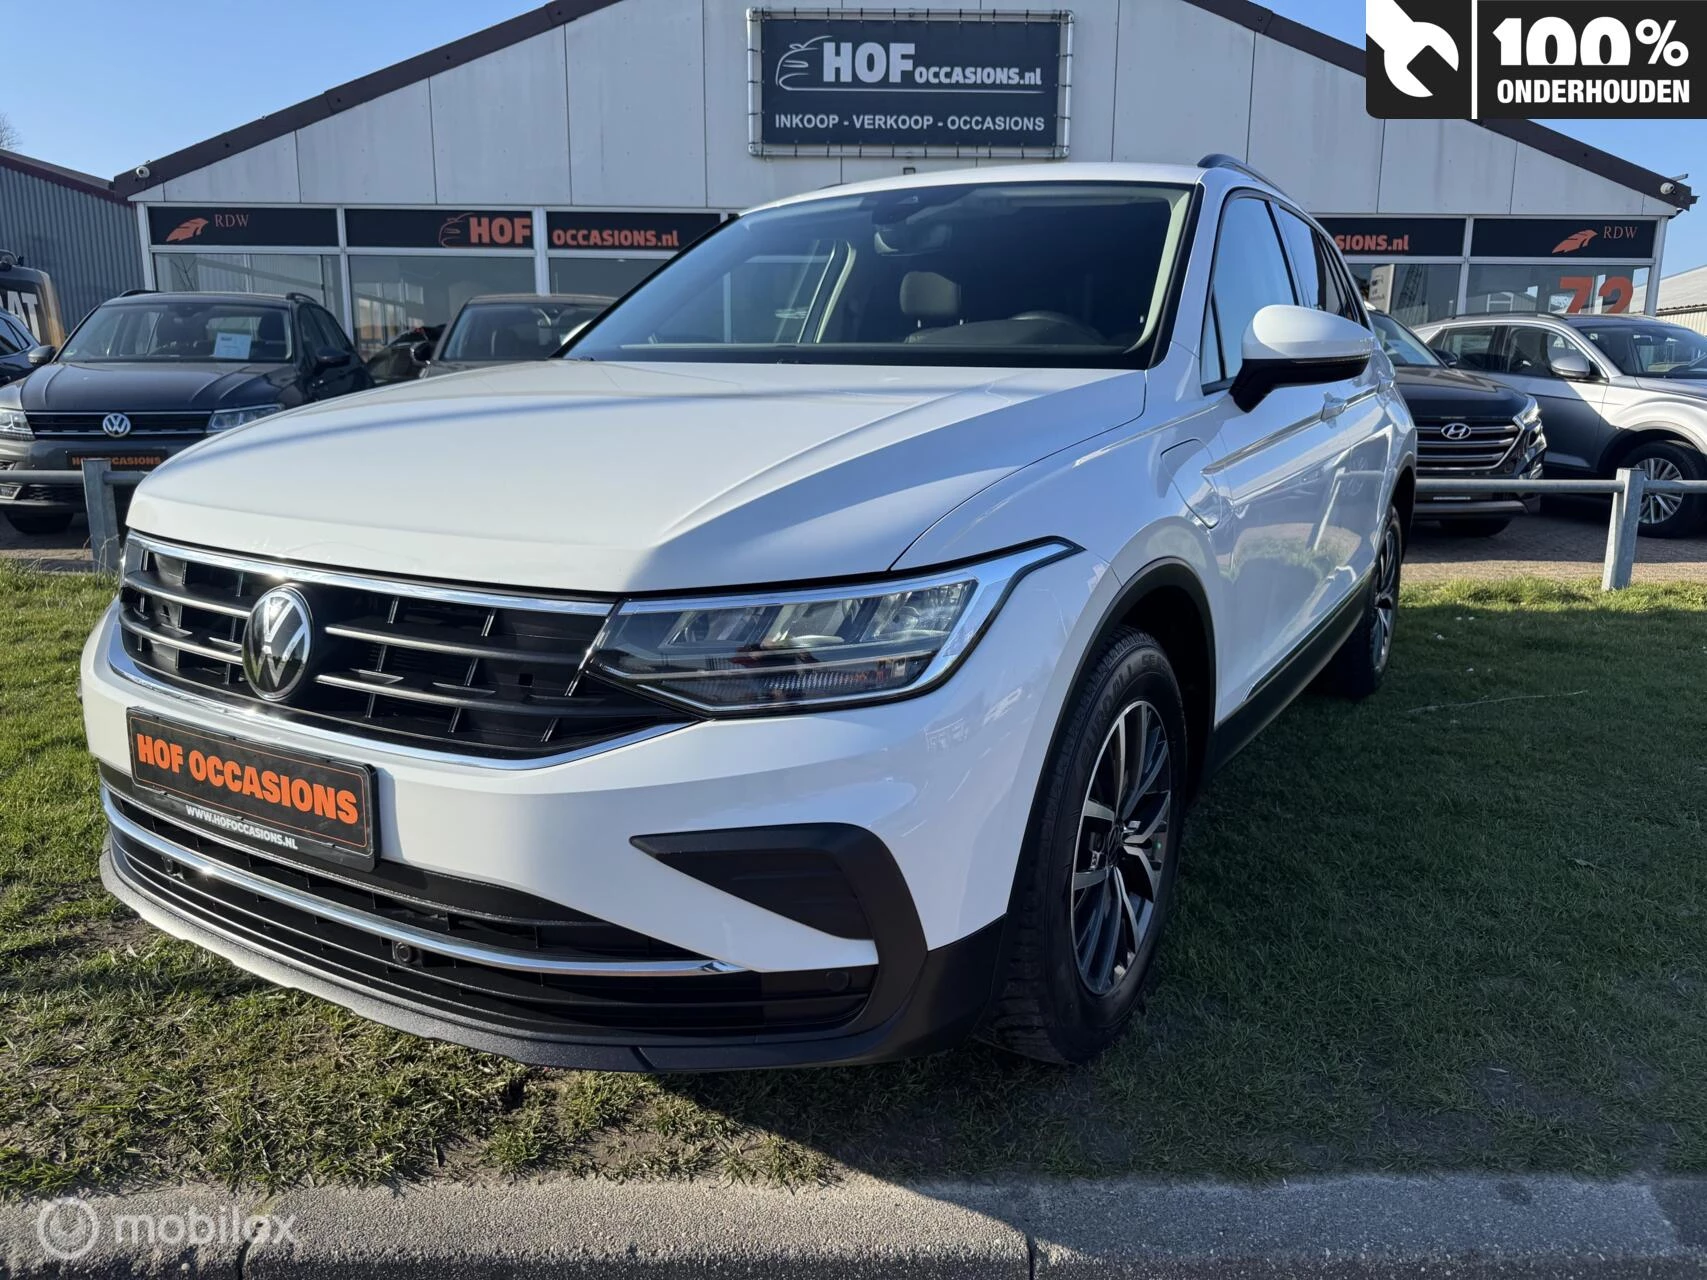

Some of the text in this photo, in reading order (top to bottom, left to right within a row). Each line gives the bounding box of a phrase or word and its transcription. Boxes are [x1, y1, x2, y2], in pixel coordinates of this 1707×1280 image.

[775, 114, 839, 129] INKOOP
[853, 115, 934, 130] VERKOOP
[947, 116, 1045, 131] OCCASIONS
[214, 213, 249, 228] RDW
[469, 217, 679, 247] HOF OCCASIONS.nl
[1603, 225, 1638, 240] RDW
[1334, 234, 1409, 251] SIONS.nl
[1559, 276, 1634, 314] 72
[111, 455, 162, 466] CASIONS
[137, 733, 359, 825] HOF OCCASIONS
[186, 804, 299, 850] WWW.HOFOCCASIONS.NL
